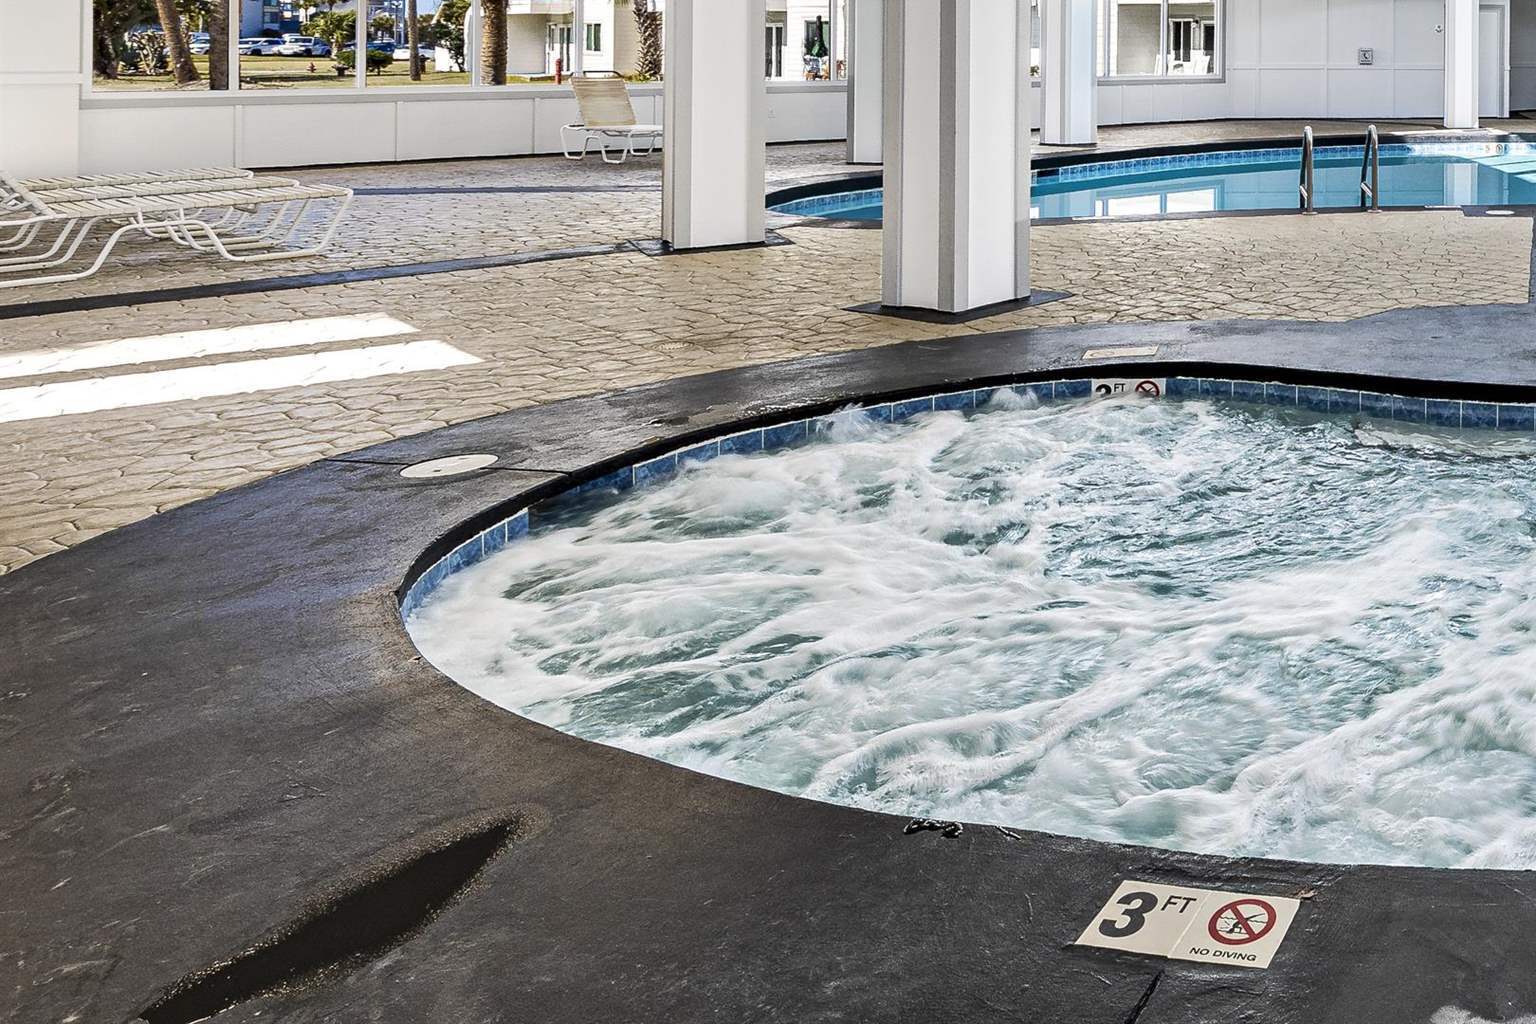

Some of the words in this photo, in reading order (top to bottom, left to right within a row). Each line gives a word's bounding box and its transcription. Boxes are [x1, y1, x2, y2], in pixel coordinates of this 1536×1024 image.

[1114, 383, 1125, 392] FT
[1098, 891, 1158, 938] 3
[1160, 895, 1197, 914] FT
[1189, 946, 1210, 956] NO
[1212, 950, 1257, 962] DIVING
